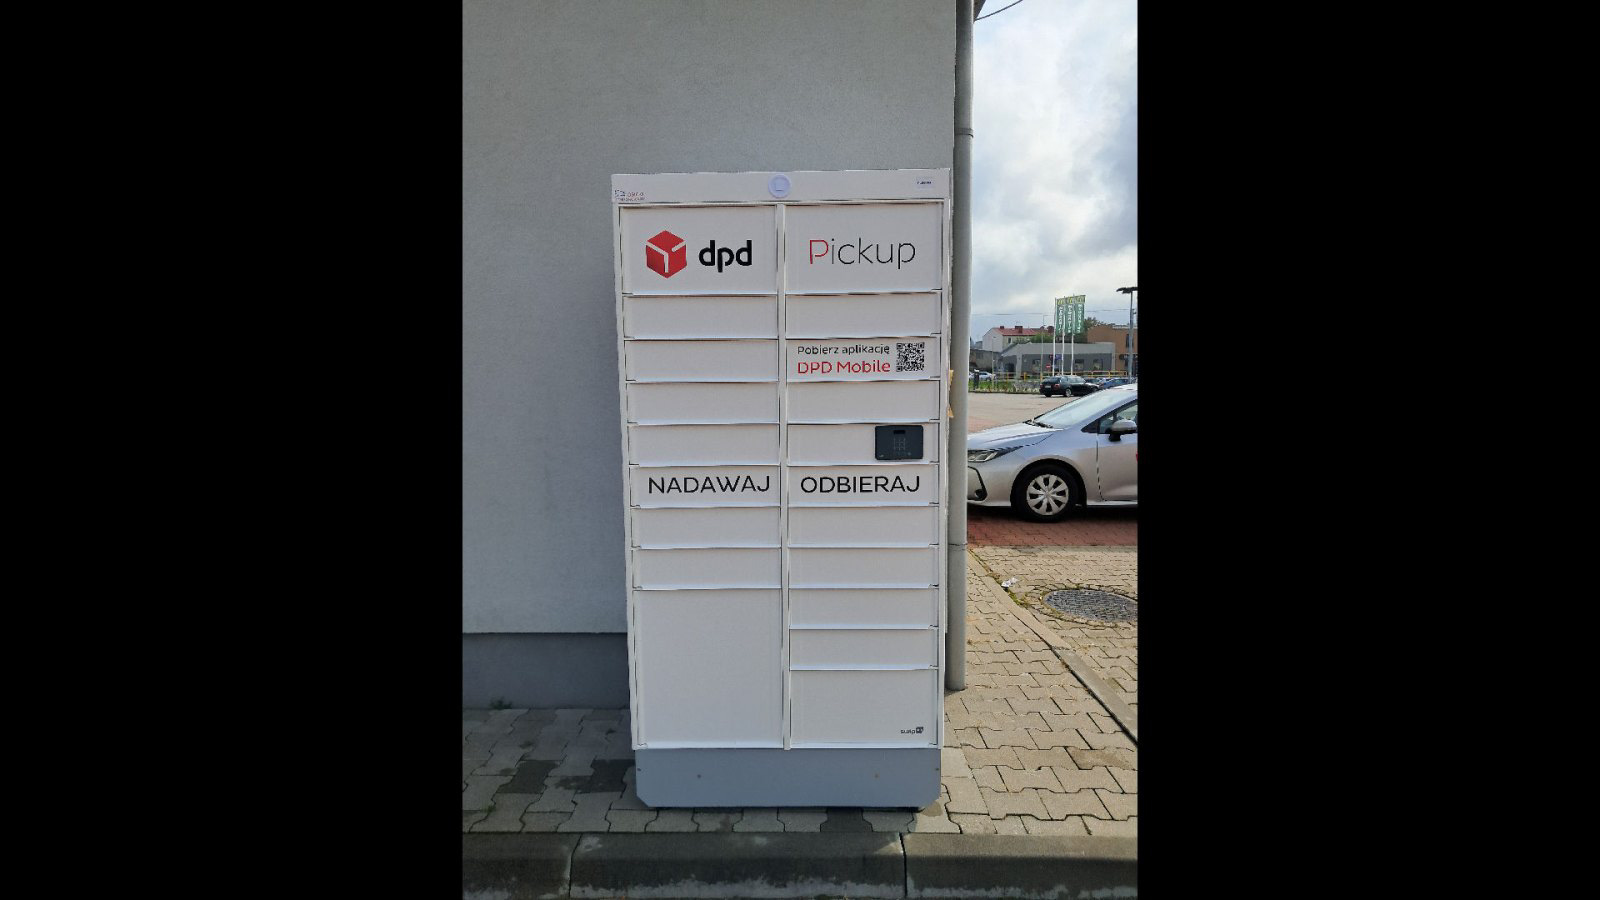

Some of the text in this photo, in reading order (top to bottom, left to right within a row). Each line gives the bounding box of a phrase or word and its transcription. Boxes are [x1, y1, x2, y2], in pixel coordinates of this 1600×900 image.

[698, 239, 753, 273] dpd
[808, 236, 917, 270] Pickup
[797, 343, 891, 356] Pobierz aplikację
[797, 359, 891, 375] DPD Mobile
[648, 475, 771, 494] NADAWAJ
[799, 475, 921, 494] ODBIERAJ
